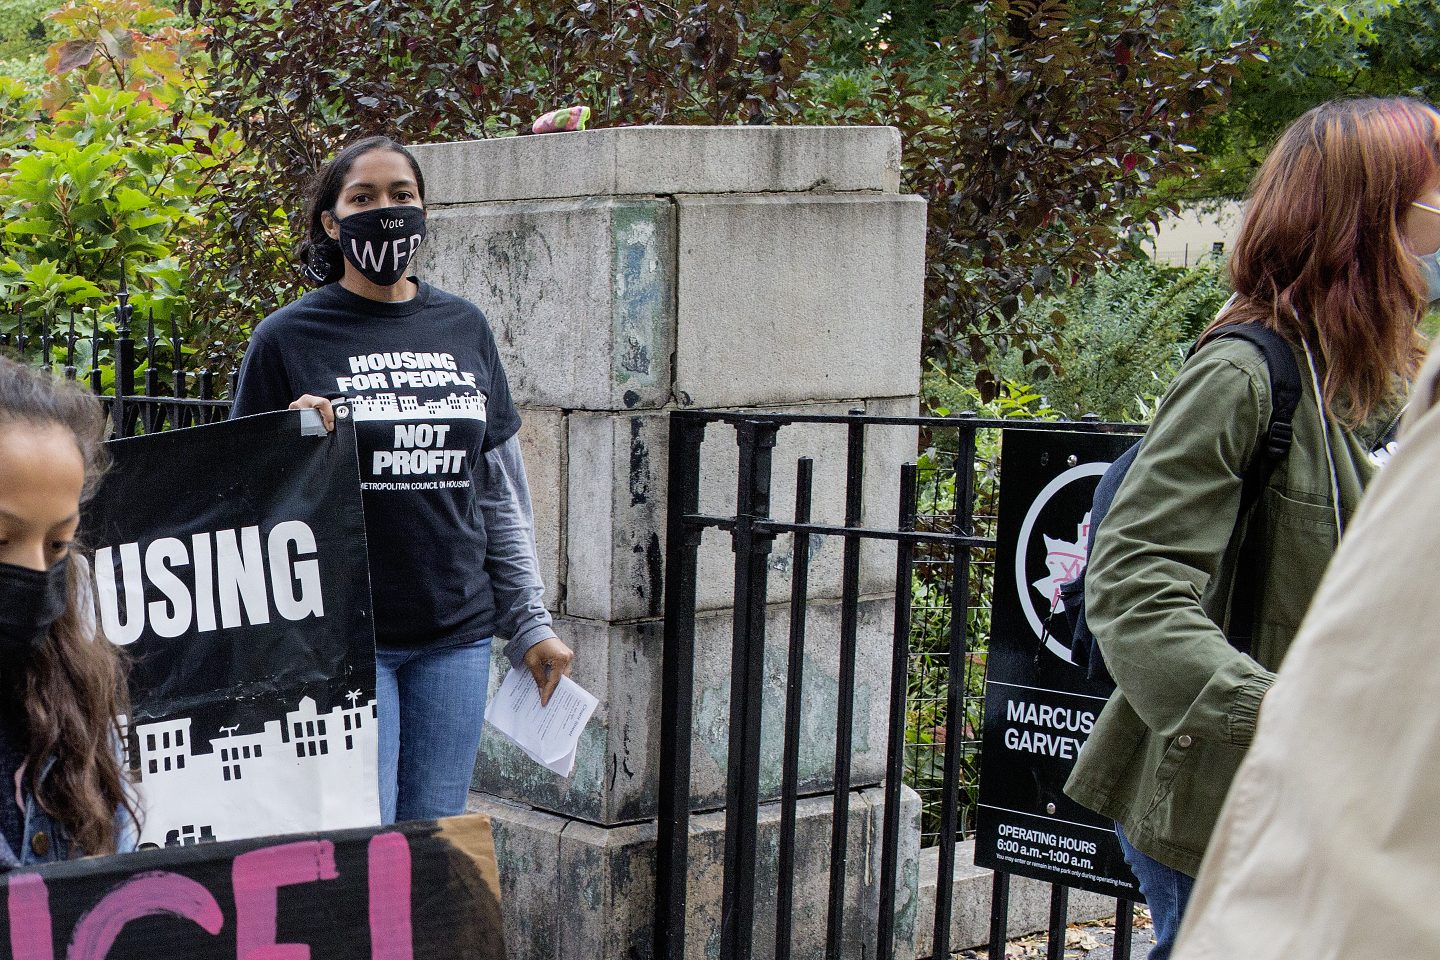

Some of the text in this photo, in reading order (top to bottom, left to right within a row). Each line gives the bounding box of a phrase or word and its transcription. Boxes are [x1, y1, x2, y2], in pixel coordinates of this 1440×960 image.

[380, 218, 404, 229] Vote
[351, 234, 421, 272] WFP
[348, 352, 457, 373] HOUSING
[336, 371, 476, 392] FOR PEOPLE
[394, 424, 450, 448] NOT
[372, 449, 467, 475] PROFIT
[360, 482, 410, 490] METROPOLITAN
[411, 482, 438, 490] COUNCIL
[446, 480, 471, 488] HOUSING
[77, 519, 325, 646] USING
[1006, 700, 1095, 734] MARCUS
[998, 824, 1096, 854] OPERATING HOURS
[996, 852, 1004, 860] You
[997, 838, 1019, 853] 6:00
[1071, 856, 1093, 870] a.m.
